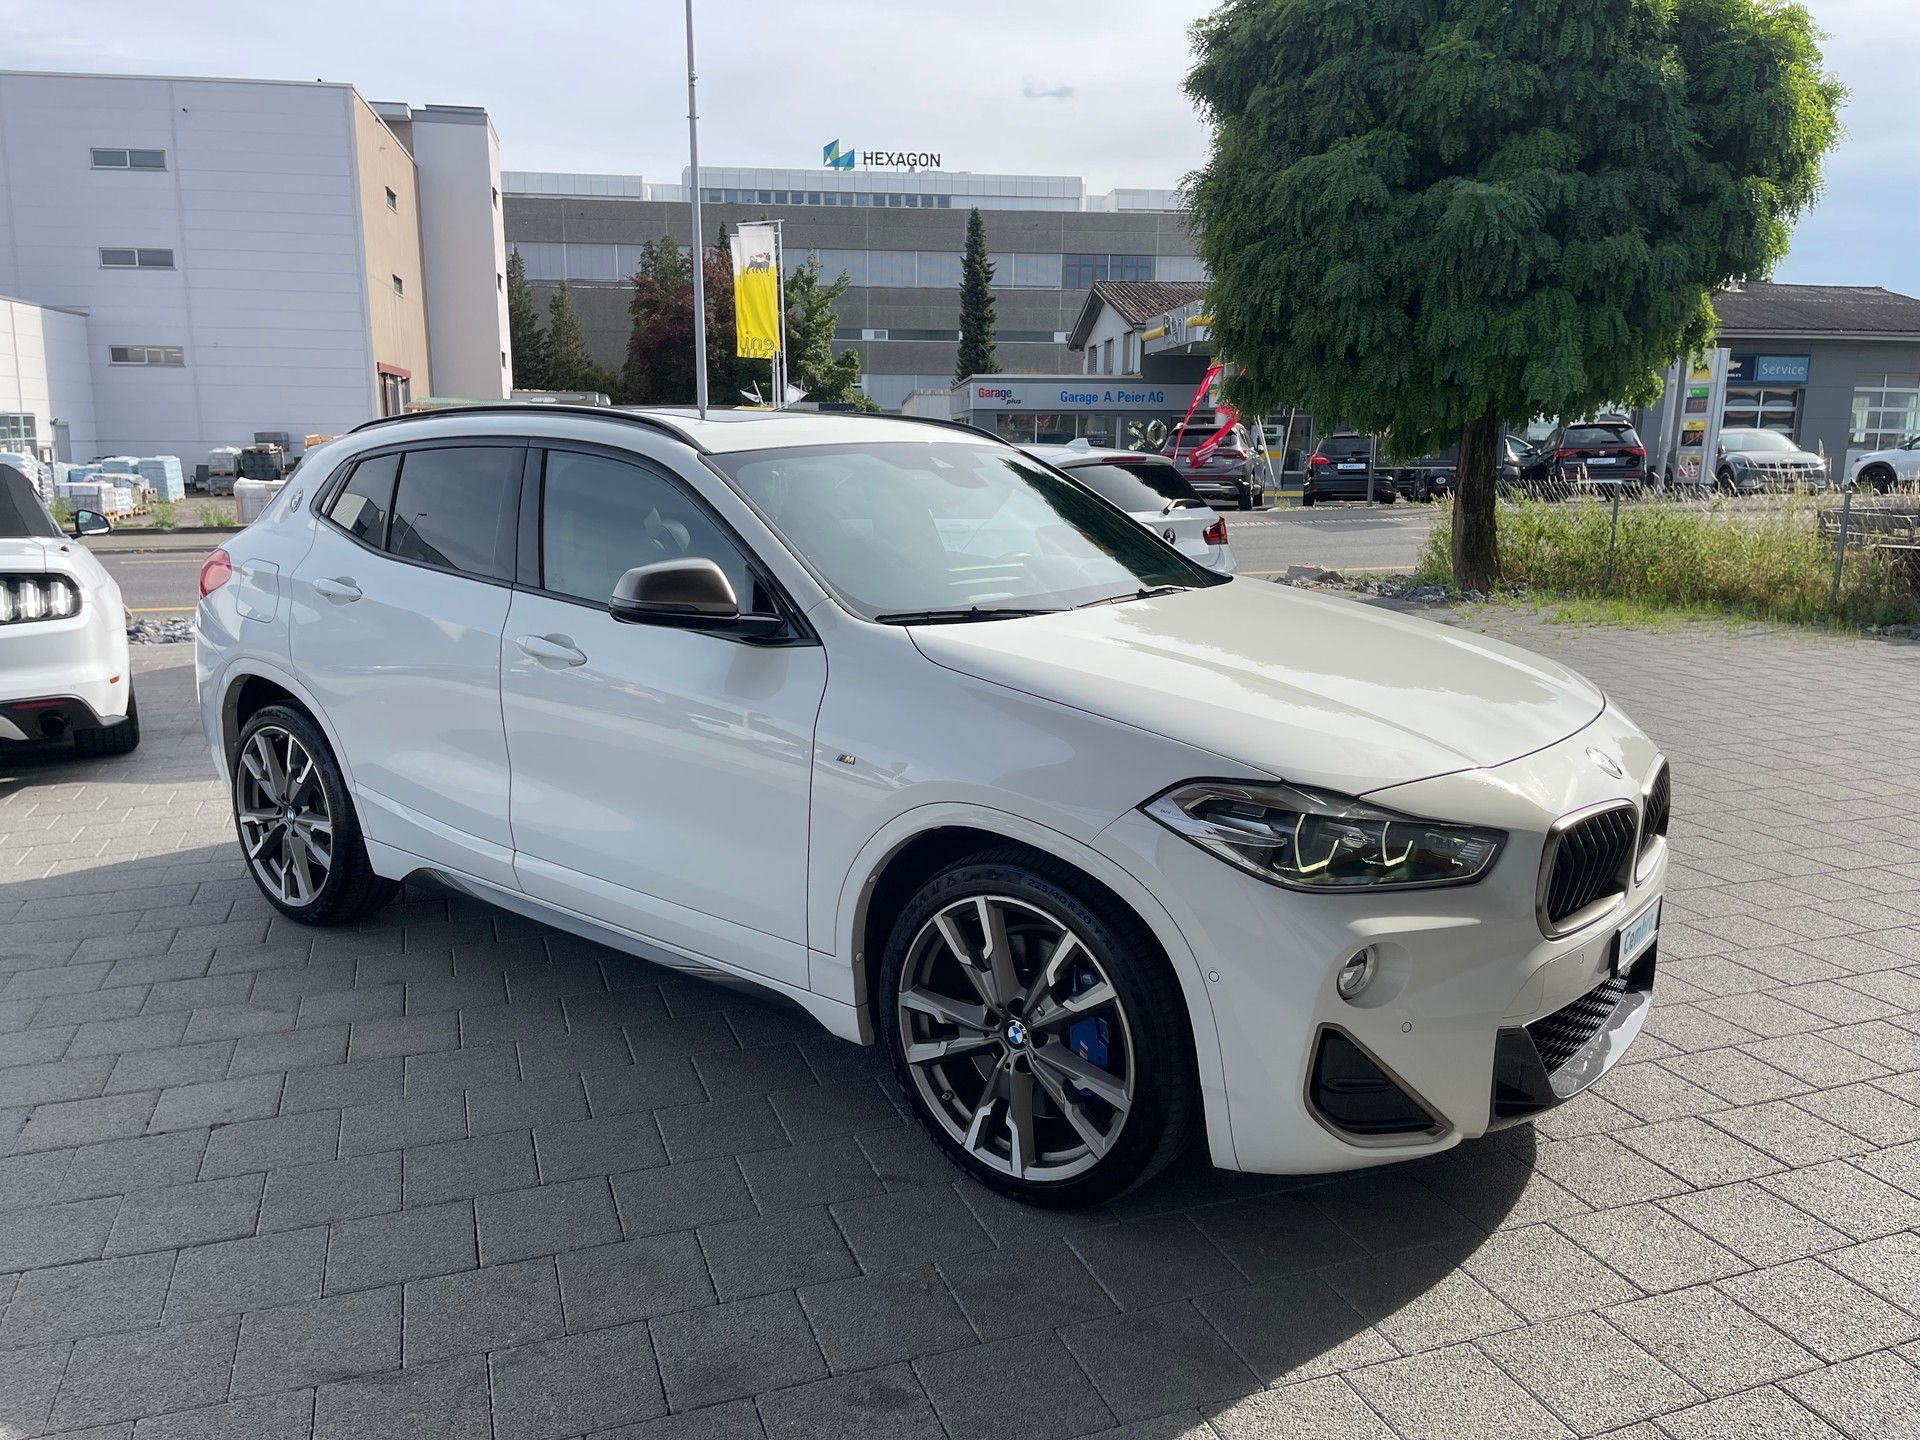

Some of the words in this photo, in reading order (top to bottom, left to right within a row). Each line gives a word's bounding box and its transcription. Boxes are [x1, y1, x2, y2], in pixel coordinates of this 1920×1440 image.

[863, 151, 941, 168] HEXAGON
[1761, 362, 1805, 376] Service
[978, 387, 1012, 401] Garage
[1060, 390, 1098, 405] Garage
[1103, 391, 1114, 402] A.
[1117, 391, 1146, 402] Peier
[1148, 391, 1164, 402] AG
